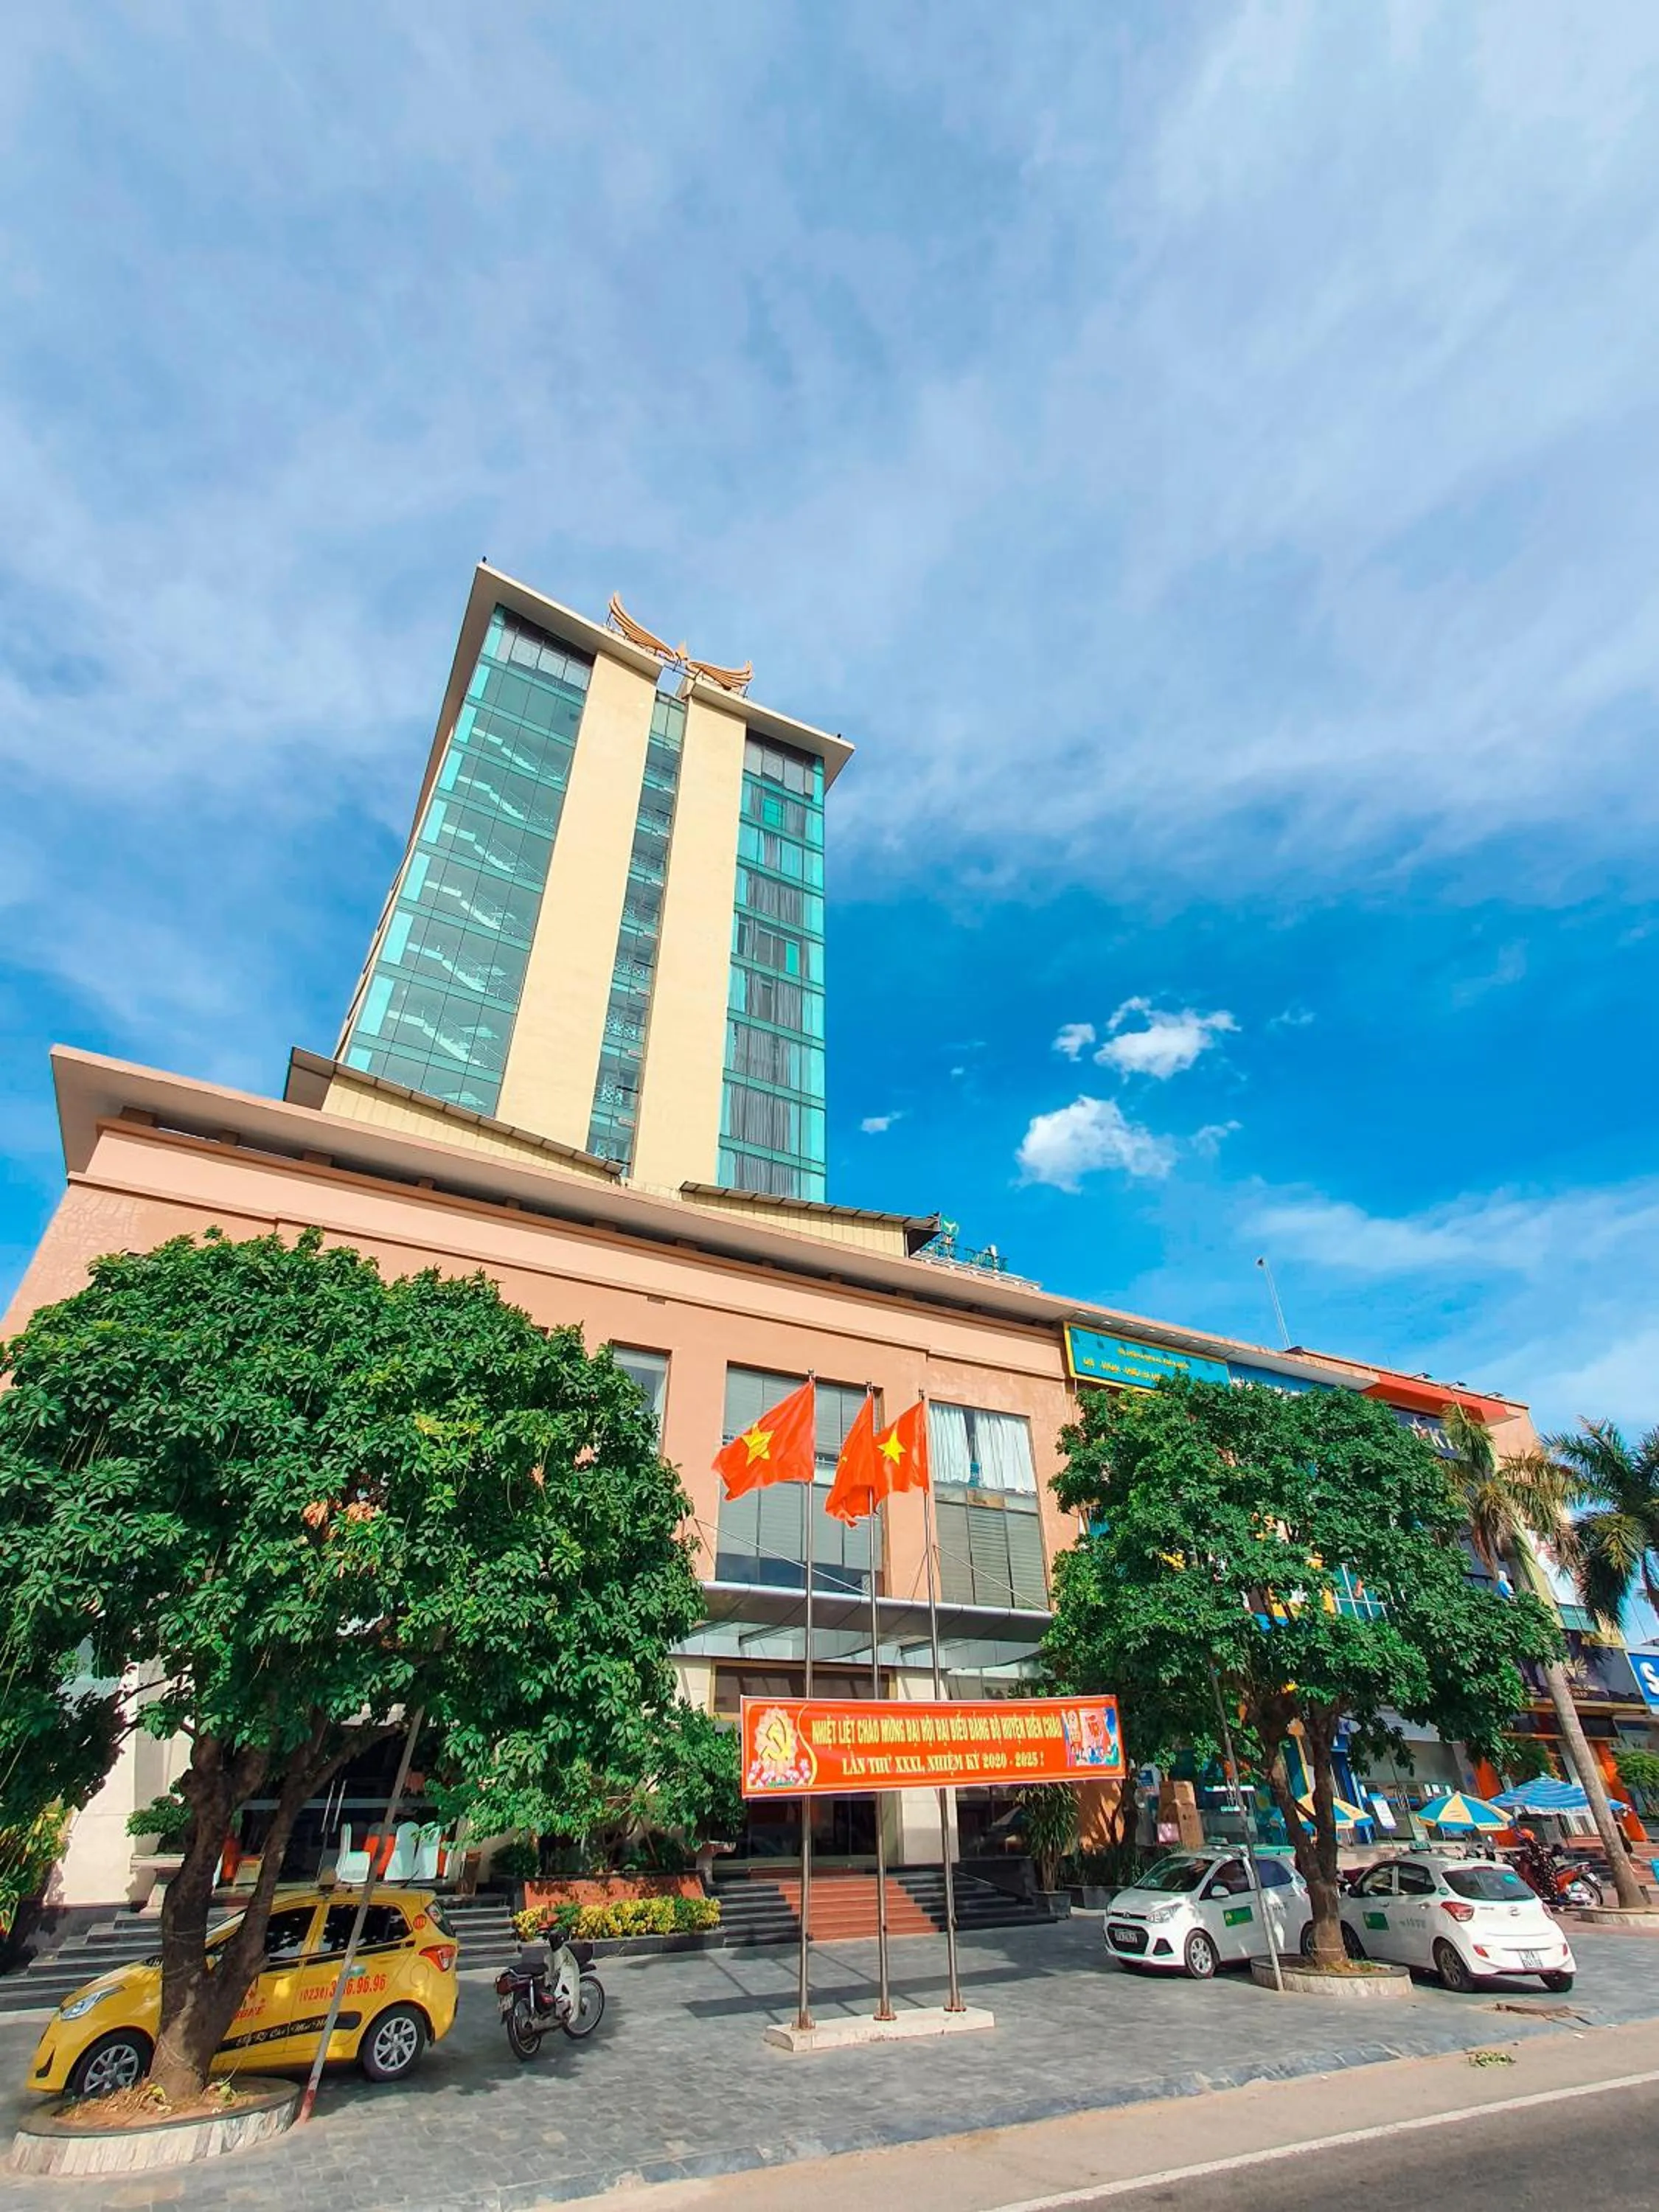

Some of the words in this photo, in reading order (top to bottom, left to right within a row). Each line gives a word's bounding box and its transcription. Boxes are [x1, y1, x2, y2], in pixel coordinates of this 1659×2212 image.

[812, 1714, 836, 1751] NHIỆT
[838, 1715, 855, 1750] LIỆT
[858, 1714, 880, 1744] CHÀO
[843, 1750, 865, 1775] LẦN
[982, 1753, 1007, 1769] 2020
[1015, 1751, 1038, 1767] 2025
